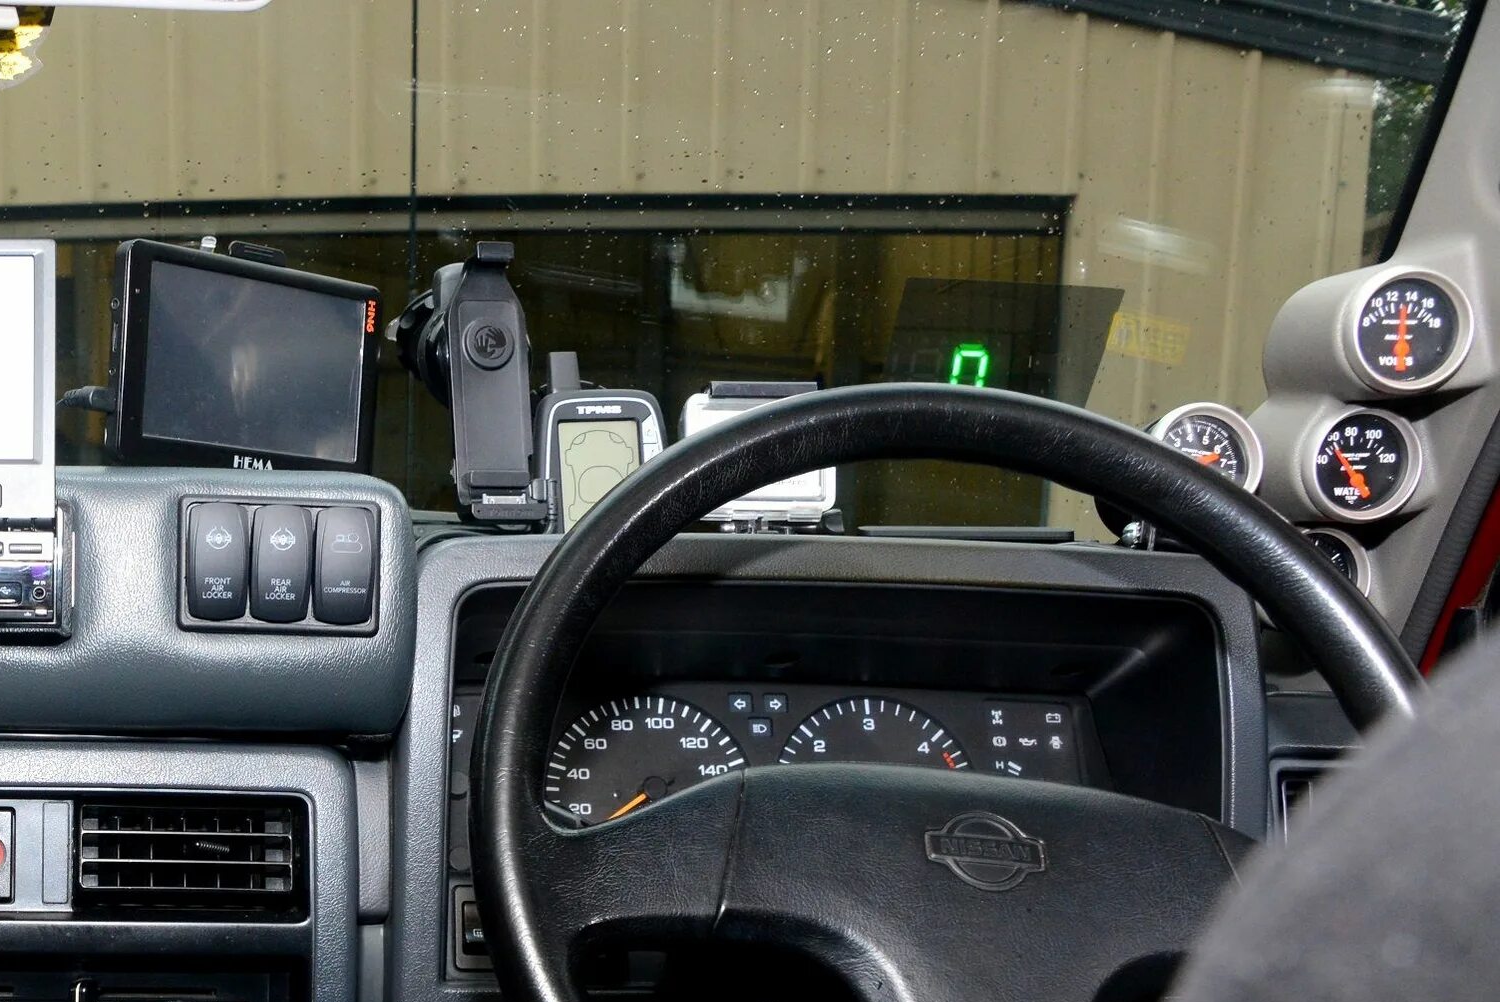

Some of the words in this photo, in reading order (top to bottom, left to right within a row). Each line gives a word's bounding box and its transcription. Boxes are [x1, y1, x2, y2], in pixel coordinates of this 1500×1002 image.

[1362, 317, 1370, 327] 8
[1371, 297, 1383, 307] 10
[1385, 291, 1399, 301] 12
[1405, 291, 1418, 301] 14
[1421, 298, 1434, 308] 16
[1428, 318, 1441, 328] 18
[576, 405, 622, 415] TPMS
[1173, 439, 1181, 447] 3
[1186, 434, 1194, 442] 4
[1202, 436, 1210, 445] 5
[1214, 445, 1221, 454] 6
[1220, 459, 1228, 467] 7
[1344, 427, 1358, 437] 80
[1365, 429, 1382, 439] 100
[1379, 453, 1396, 463] 120
[233, 455, 273, 470] HEMA
[1333, 487, 1361, 496] WATE
[204, 577, 231, 585] FRONT
[270, 578, 291, 586] REAR
[202, 591, 233, 599] LOCKER
[323, 586, 367, 594] COMPRESSOR
[265, 592, 296, 600] LOCKER
[611, 719, 633, 731] 80
[645, 718, 674, 729] 100
[813, 740, 826, 752] 2
[863, 719, 875, 731] 3
[917, 742, 930, 754] 4
[584, 738, 607, 749] 60
[679, 738, 709, 748] 120
[567, 768, 590, 779] 40
[698, 765, 728, 776] 140
[569, 804, 592, 815] 20
[939, 838, 1031, 861] NISSAN
